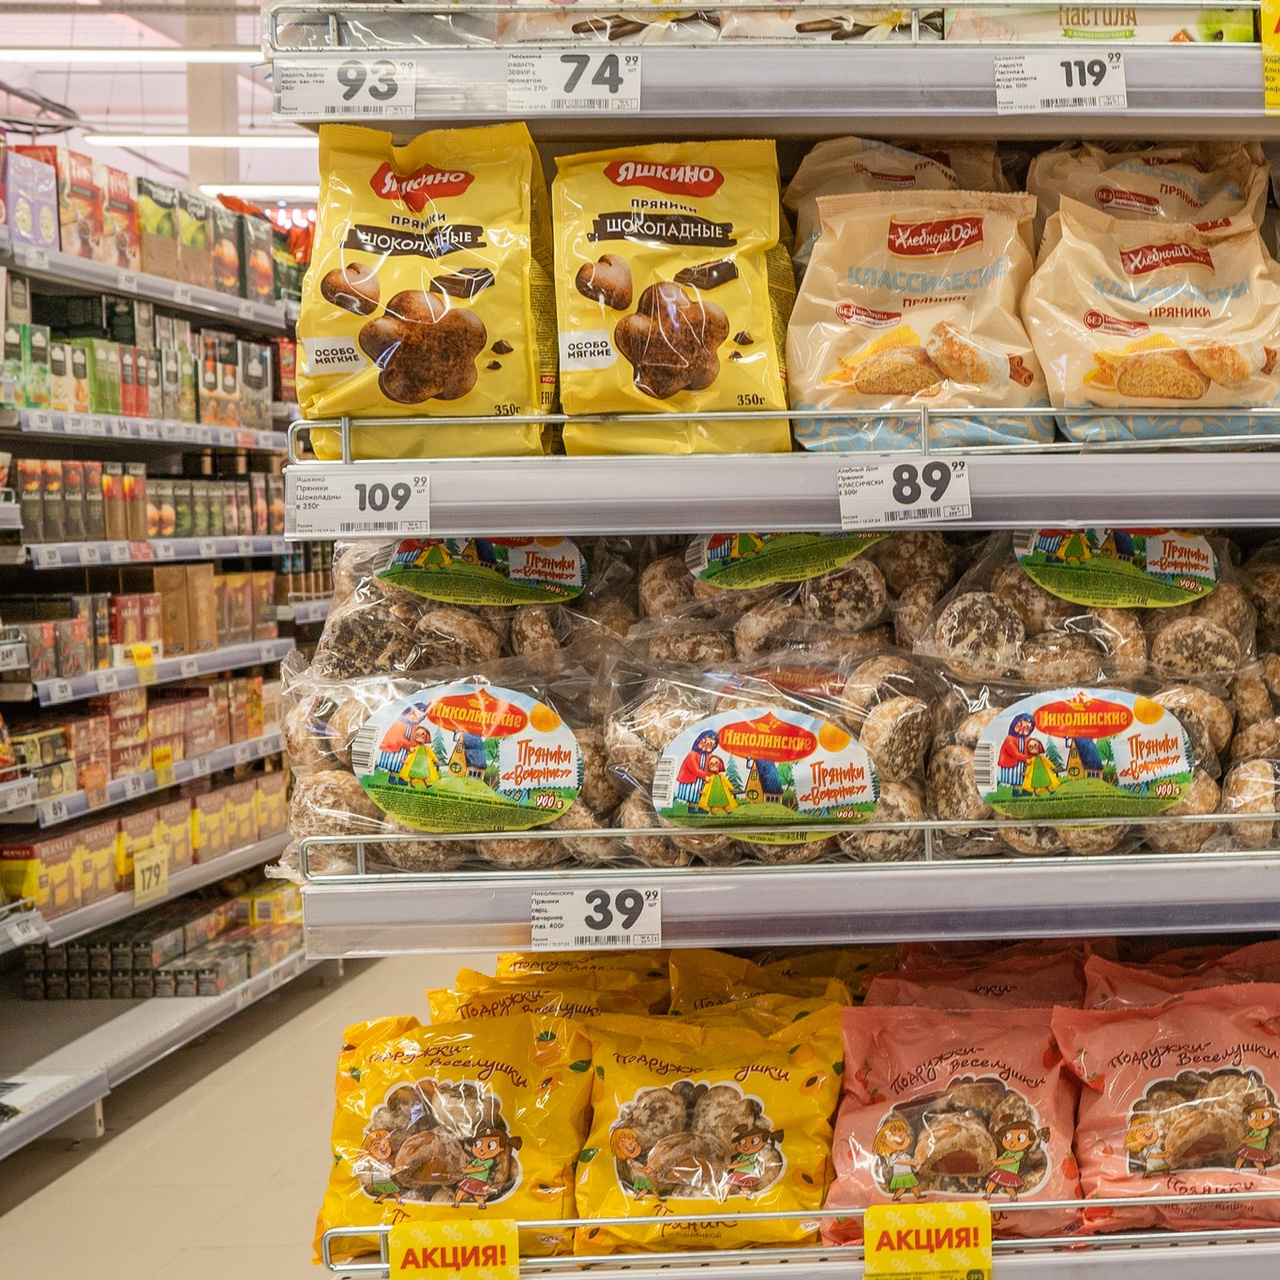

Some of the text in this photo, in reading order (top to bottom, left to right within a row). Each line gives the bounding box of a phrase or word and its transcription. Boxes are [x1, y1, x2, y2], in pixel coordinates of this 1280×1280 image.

[338, 60, 398, 99] 93
[560, 54, 638, 93] 74 99
[1060, 53, 1121, 87] 119 99
[631, 199, 697, 214] ПРЯНИКИ
[606, 218, 723, 238] ШОКОЛАДНЫЕ
[848, 257, 1007, 294] КЛАССИЧЕСКИЕ
[1149, 306, 1211, 318] ПРЯНИКИ
[314, 348, 355, 358] ОСОБО
[314, 354, 360, 365] МЯГКИЕ
[567, 349, 612, 359] МЯГКИЕ
[568, 342, 608, 351] ОСОБО
[737, 394, 765, 406] 350г
[355, 476, 427, 511] 109 99
[893, 461, 965, 504] 89 99
[1040, 709, 1128, 731] Николинские
[517, 739, 571, 765] Пряники
[721, 729, 813, 755] Николинские
[1128, 733, 1179, 764] Пряники
[810, 762, 864, 788] Пряники
[141, 863, 161, 890] 179
[585, 889, 658, 930] 39 99
[876, 1227, 979, 1251] АКЦИЯ!
[400, 1244, 506, 1270] АКЦИЯ!
